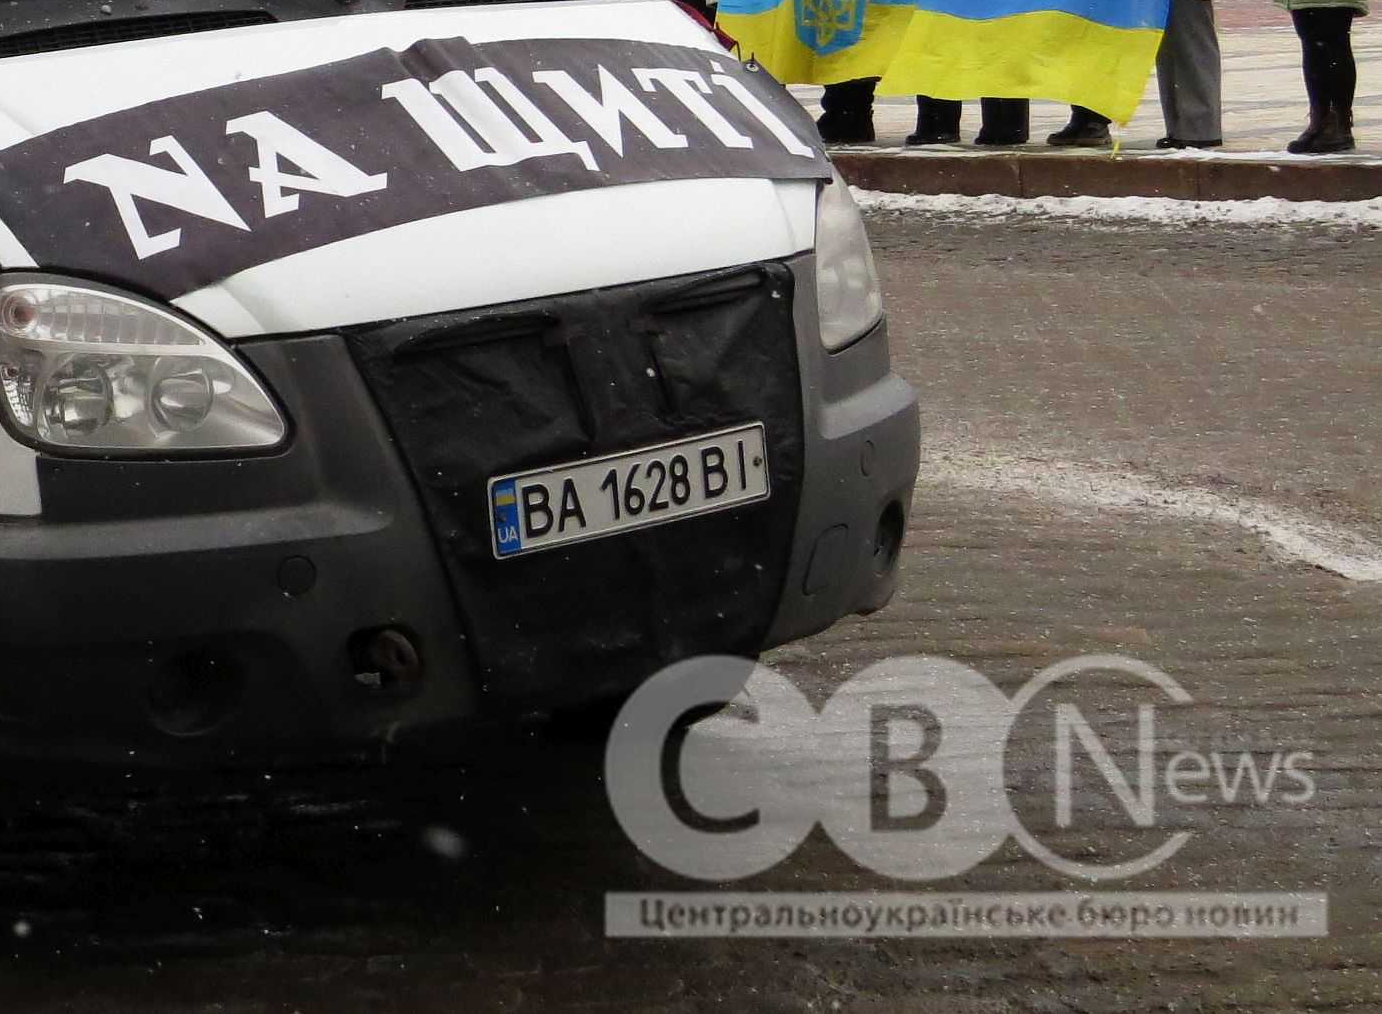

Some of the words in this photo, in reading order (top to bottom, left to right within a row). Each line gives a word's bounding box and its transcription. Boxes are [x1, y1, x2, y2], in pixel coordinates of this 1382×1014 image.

[381, 61, 816, 172] ЩИТІ
[497, 525, 519, 544] UA
[521, 477, 587, 539] BA
[599, 454, 692, 521] 1628
